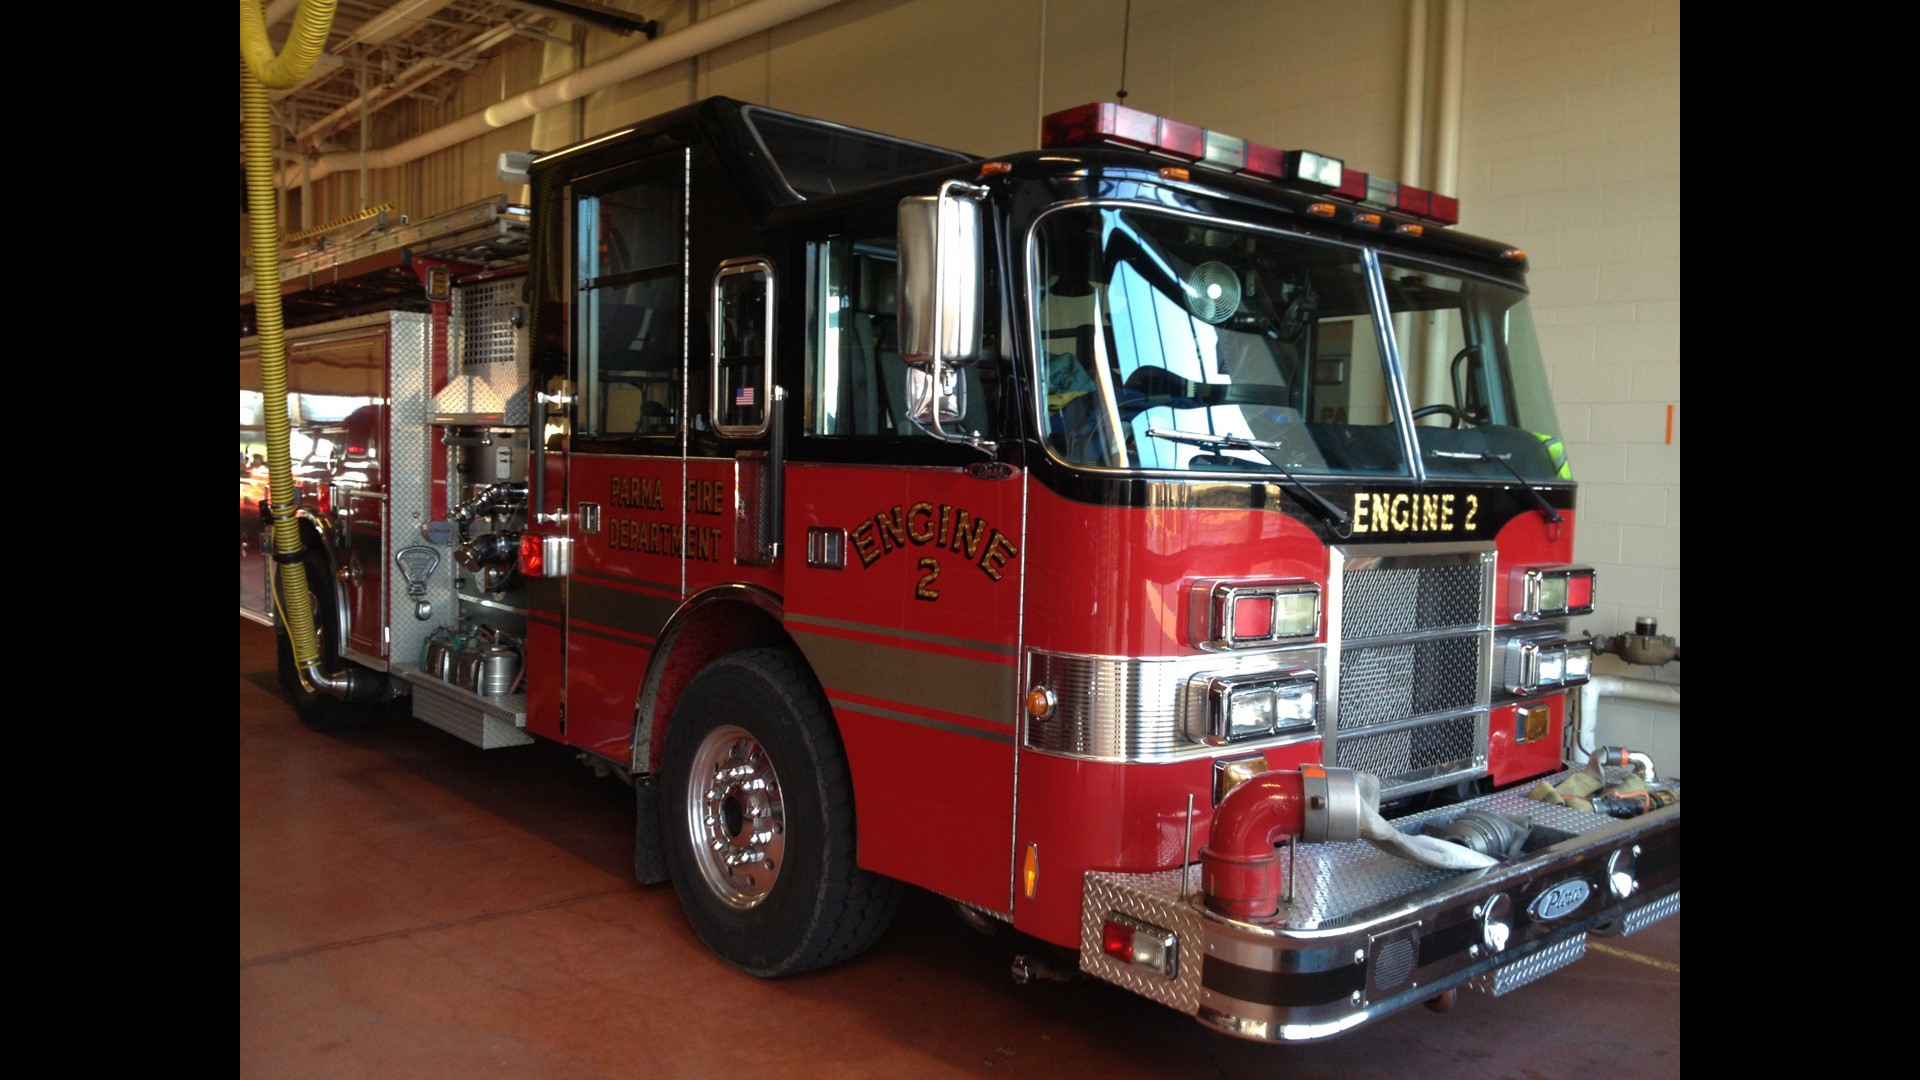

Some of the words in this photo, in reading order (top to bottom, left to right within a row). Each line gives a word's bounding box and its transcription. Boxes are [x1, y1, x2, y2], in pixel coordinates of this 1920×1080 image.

[610, 475, 664, 511] PARMA
[685, 479, 724, 515] FIRE
[1353, 493, 1455, 532] ENGINE
[1464, 494, 1478, 530] 2
[609, 517, 722, 563] DEPARTMENT
[850, 501, 1018, 582] ENGINE
[915, 556, 941, 601] 2
[1544, 887, 1583, 917] Pierce
